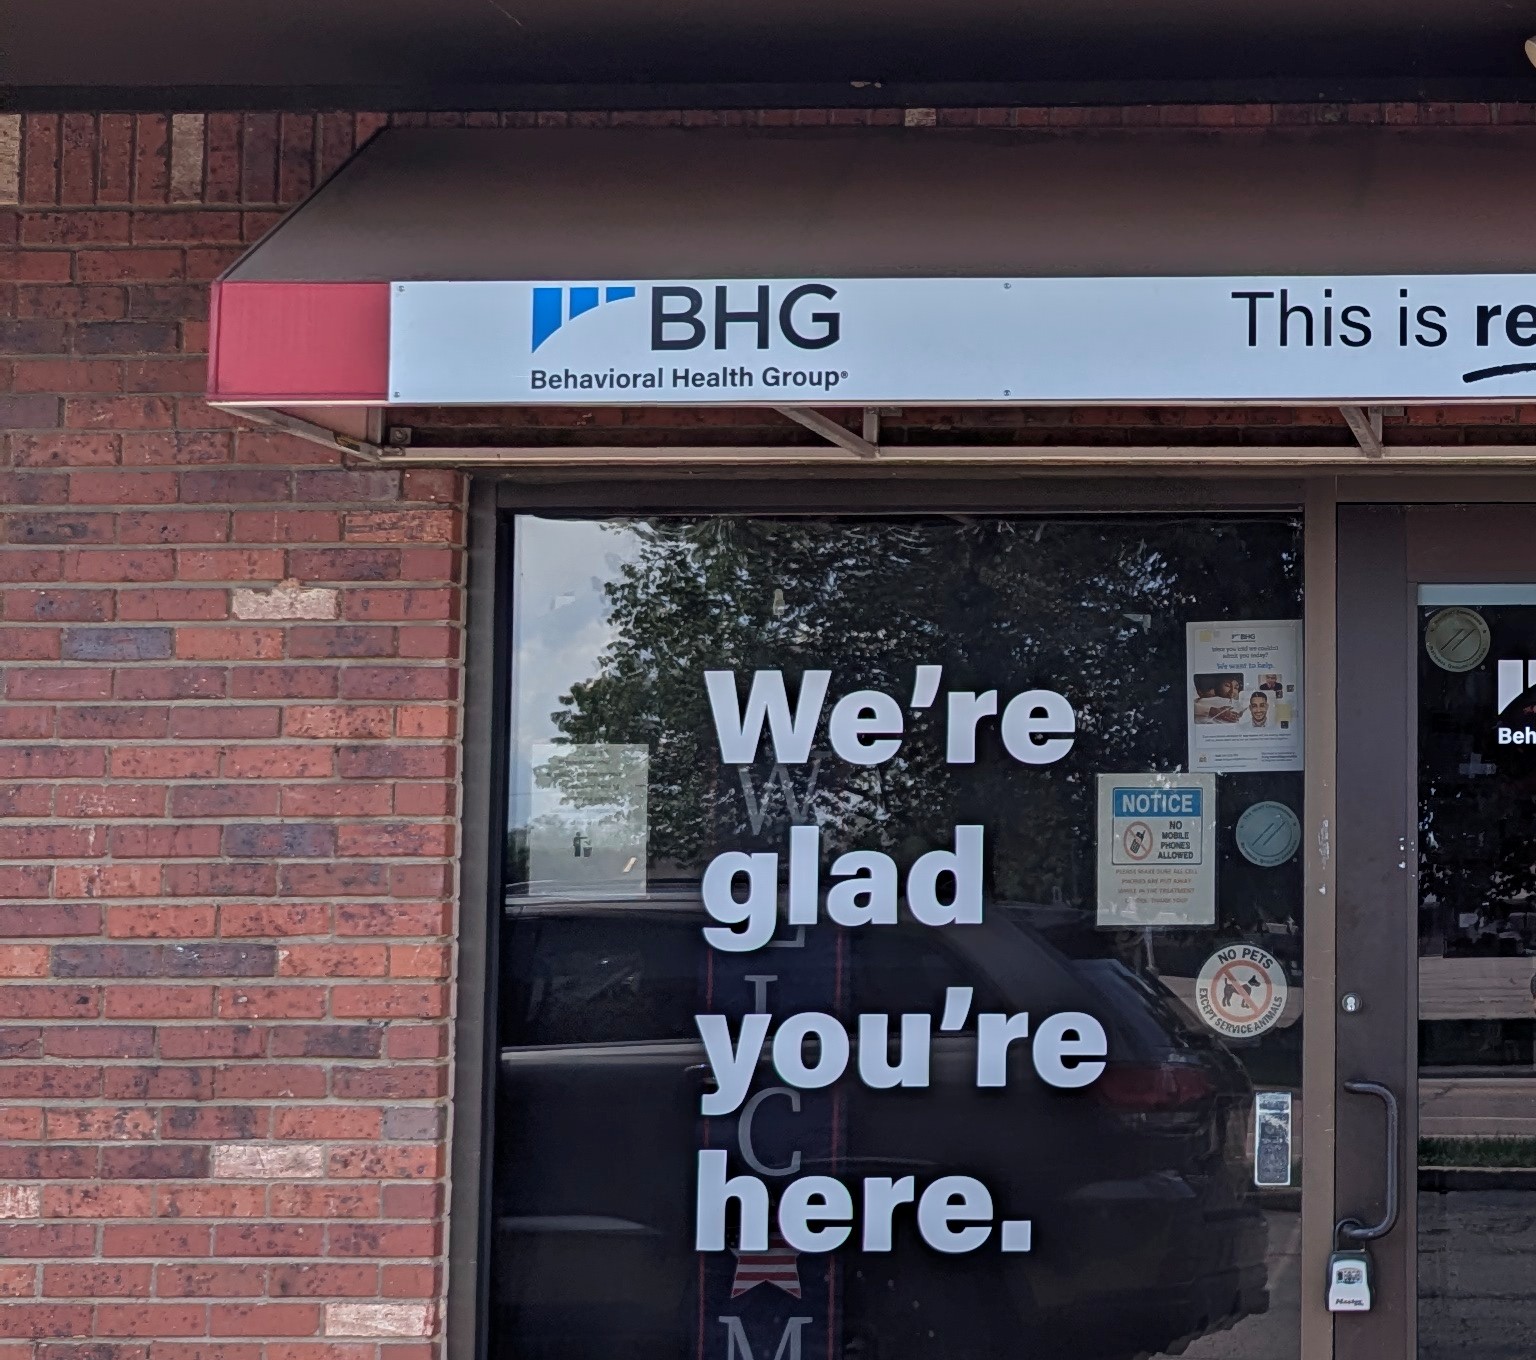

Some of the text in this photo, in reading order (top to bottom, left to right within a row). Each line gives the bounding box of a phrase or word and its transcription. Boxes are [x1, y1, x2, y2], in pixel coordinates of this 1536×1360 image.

[652, 283, 841, 350] BHG
[1231, 288, 1371, 348] This
[1399, 288, 1448, 348] is
[531, 367, 664, 390] Behavioral
[672, 366, 754, 388] Health
[704, 665, 1076, 765] We're
[1122, 794, 1193, 813] NOTICE
[1161, 831, 1190, 840] MOBILE
[1169, 820, 1182, 830] NO
[1157, 851, 1194, 859] ALLOWED
[1160, 841, 1191, 850] PHONES
[702, 825, 984, 953] glad
[1217, 948, 1237, 965] NO
[1241, 947, 1274, 970] PETS
[1199, 987, 1283, 1035] EXCEPT SERVICE ANIMALS
[695, 987, 1107, 1116] you're
[696, 1149, 1032, 1253] here.
